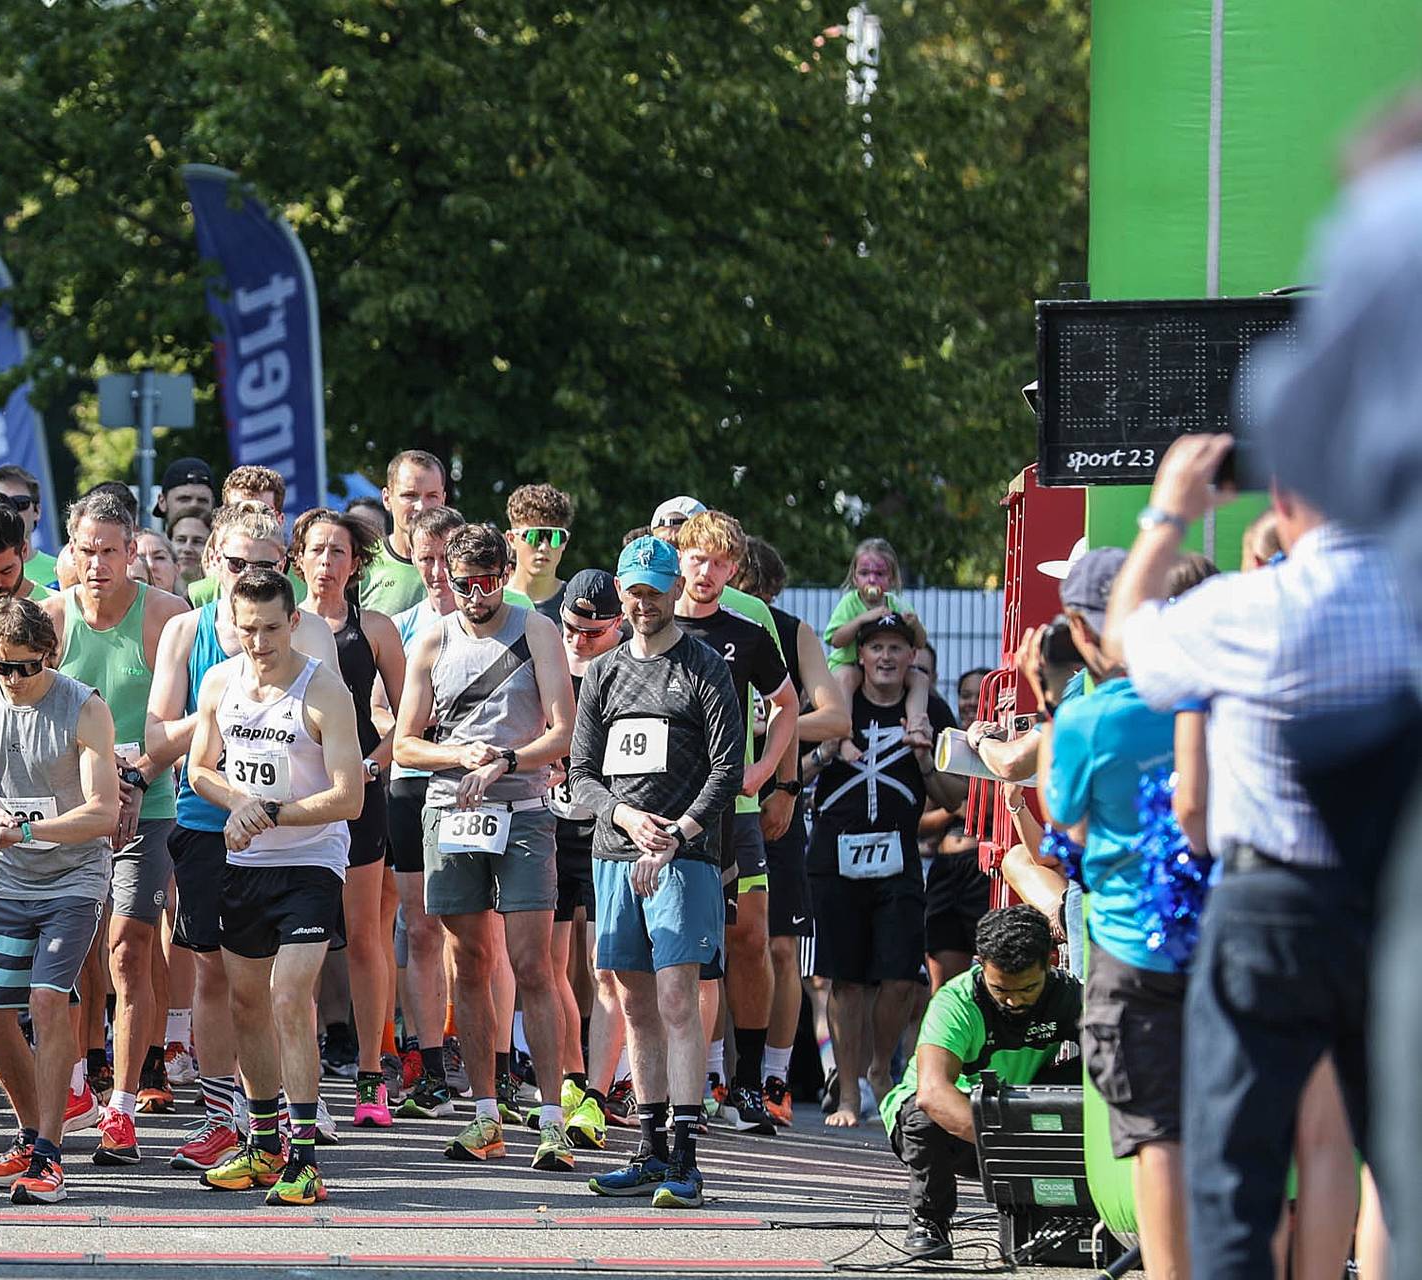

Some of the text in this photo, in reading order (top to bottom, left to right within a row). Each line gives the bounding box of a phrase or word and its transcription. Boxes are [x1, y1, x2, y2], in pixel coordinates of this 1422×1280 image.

[1067, 450, 1155, 472] sport 23
[724, 643, 735, 661] 2
[230, 724, 296, 744] RapiDOs
[619, 733, 647, 756] 49
[235, 760, 276, 786] 379
[452, 814, 498, 836] 386
[849, 843, 890, 865] 777
